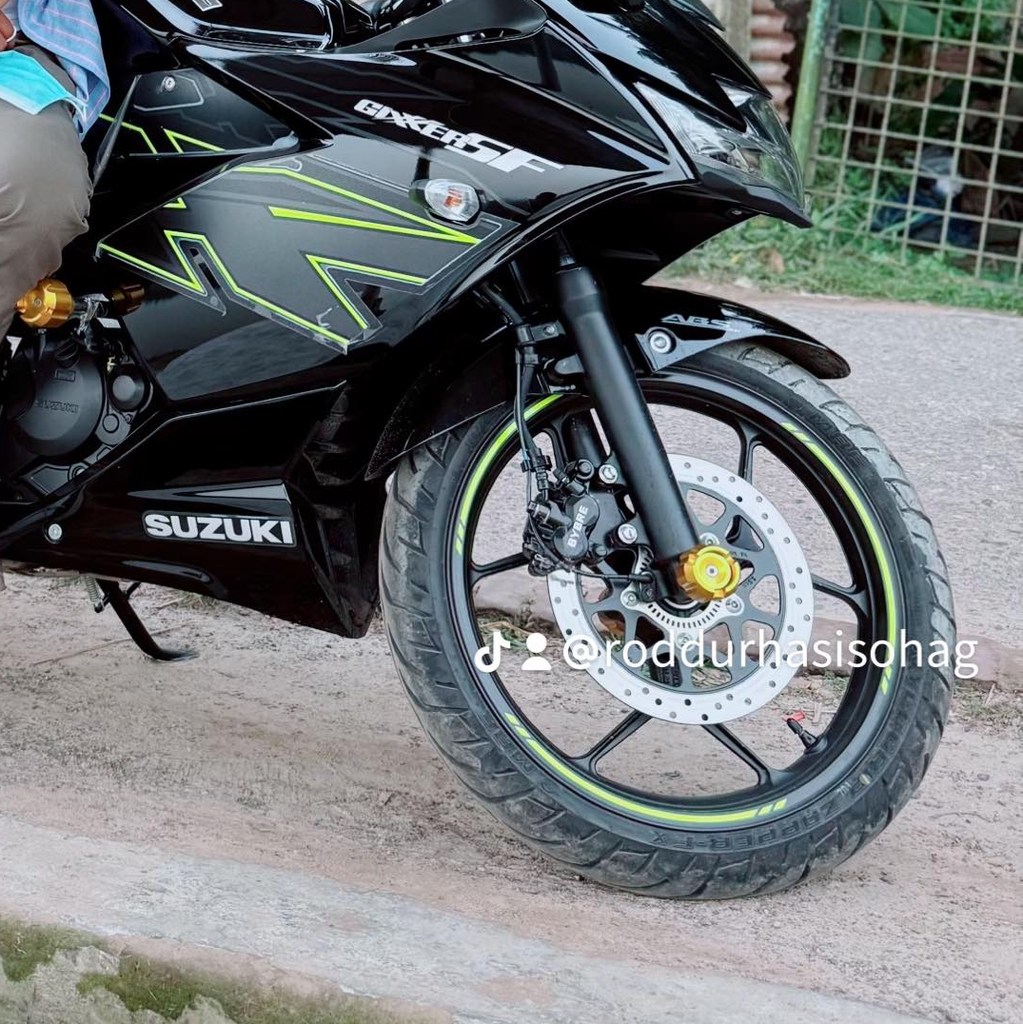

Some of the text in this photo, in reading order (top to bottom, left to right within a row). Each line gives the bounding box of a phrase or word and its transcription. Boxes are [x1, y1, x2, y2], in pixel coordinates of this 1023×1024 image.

[444, 132, 564, 173] SF
[661, 313, 733, 330] ABS
[143, 513, 294, 545] SUZUKI
[567, 504, 589, 548] BYBRE
